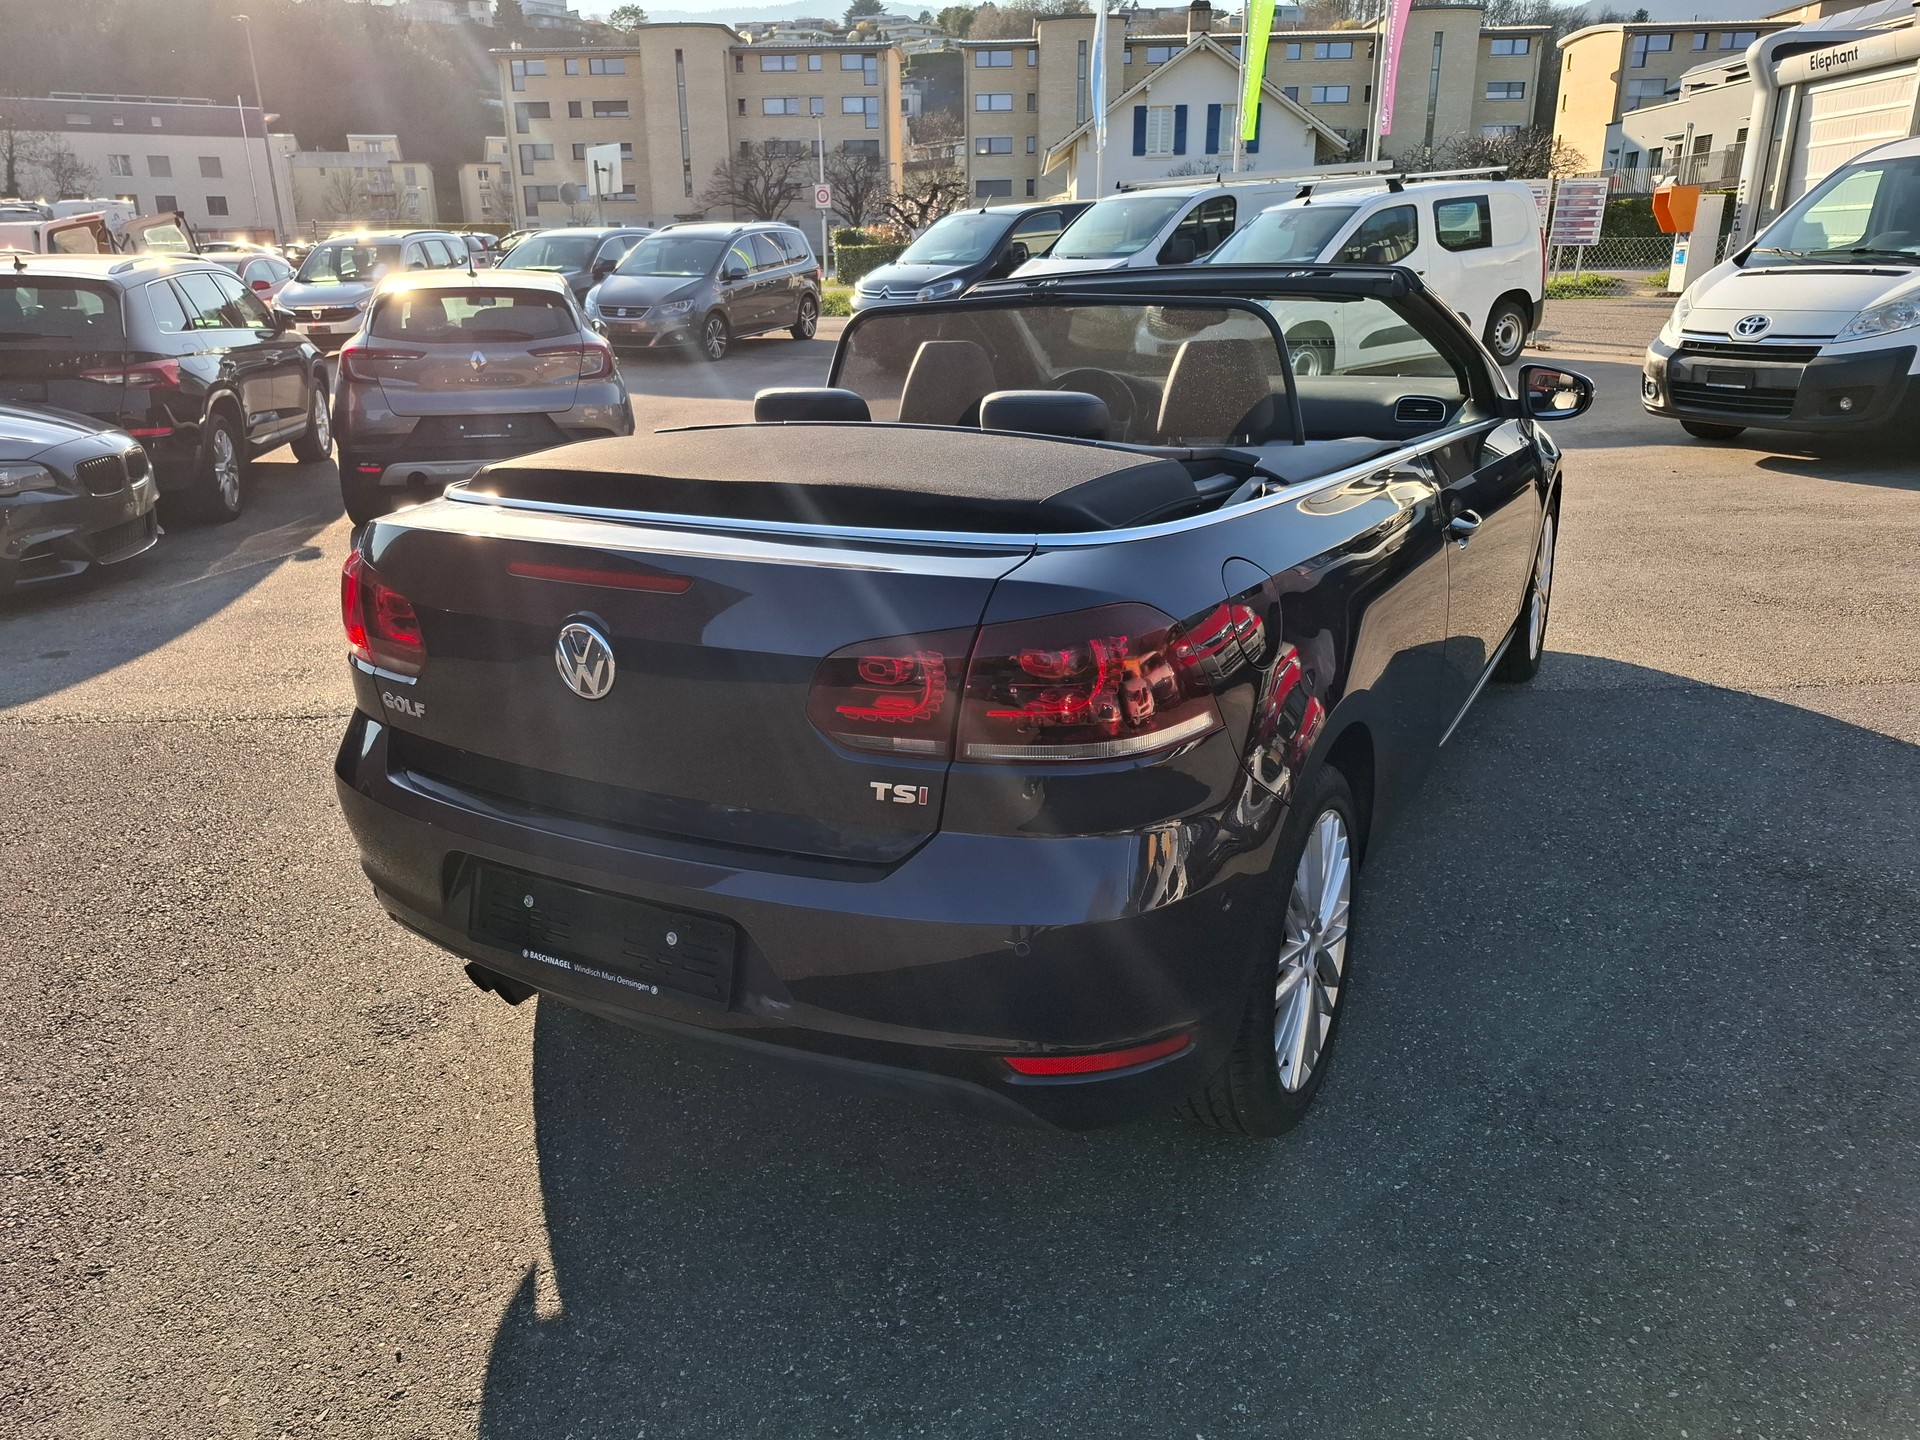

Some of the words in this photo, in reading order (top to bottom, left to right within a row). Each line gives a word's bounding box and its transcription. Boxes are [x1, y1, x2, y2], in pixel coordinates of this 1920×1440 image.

[1809, 45, 1859, 72] Eléphant
[555, 623, 616, 700] VW
[382, 691, 426, 718] GOLF
[870, 781, 929, 806] TSI
[529, 950, 572, 970] BASCHNAGEL
[573, 963, 601, 978] Windisch
[601, 971, 616, 982] Muri
[616, 975, 650, 992] Oensingen
